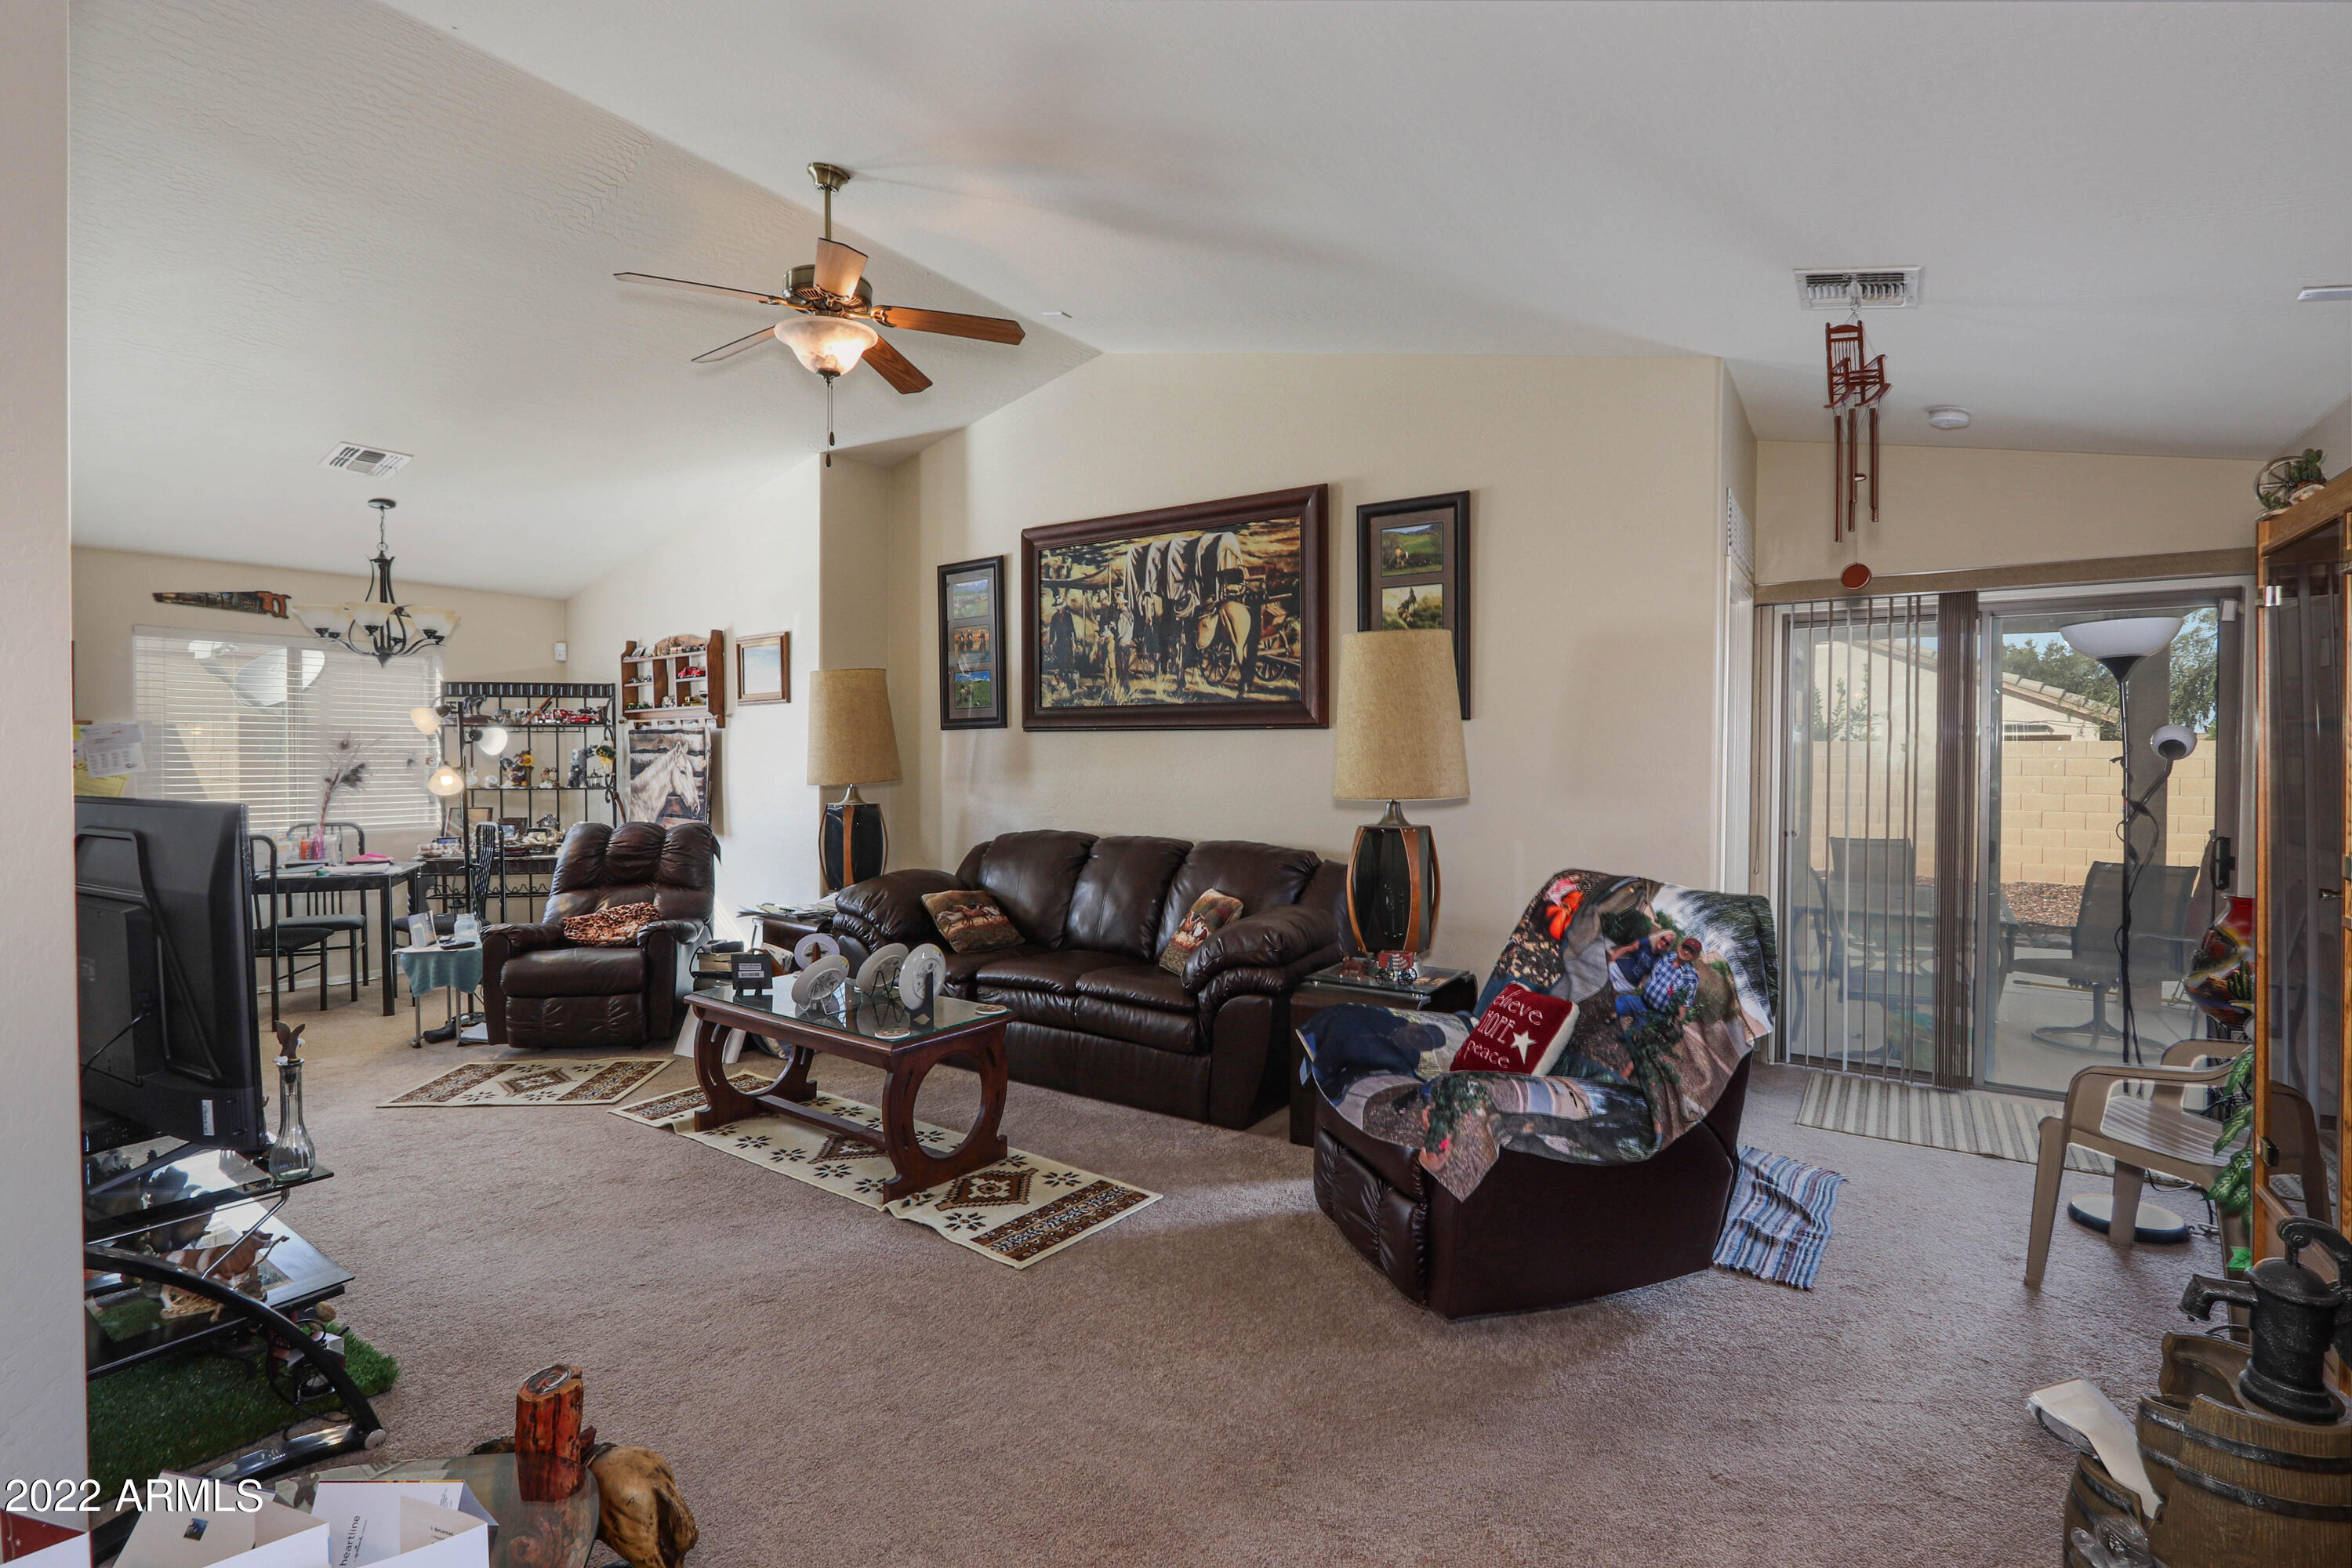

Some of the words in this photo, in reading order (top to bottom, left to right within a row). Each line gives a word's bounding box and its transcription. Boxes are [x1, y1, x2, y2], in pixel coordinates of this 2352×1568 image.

[1493, 989, 1543, 1025] elieve
[1478, 1010, 1516, 1044] HOPE
[1463, 1040, 1510, 1069] peace
[339, 1515, 361, 1566] heartline
